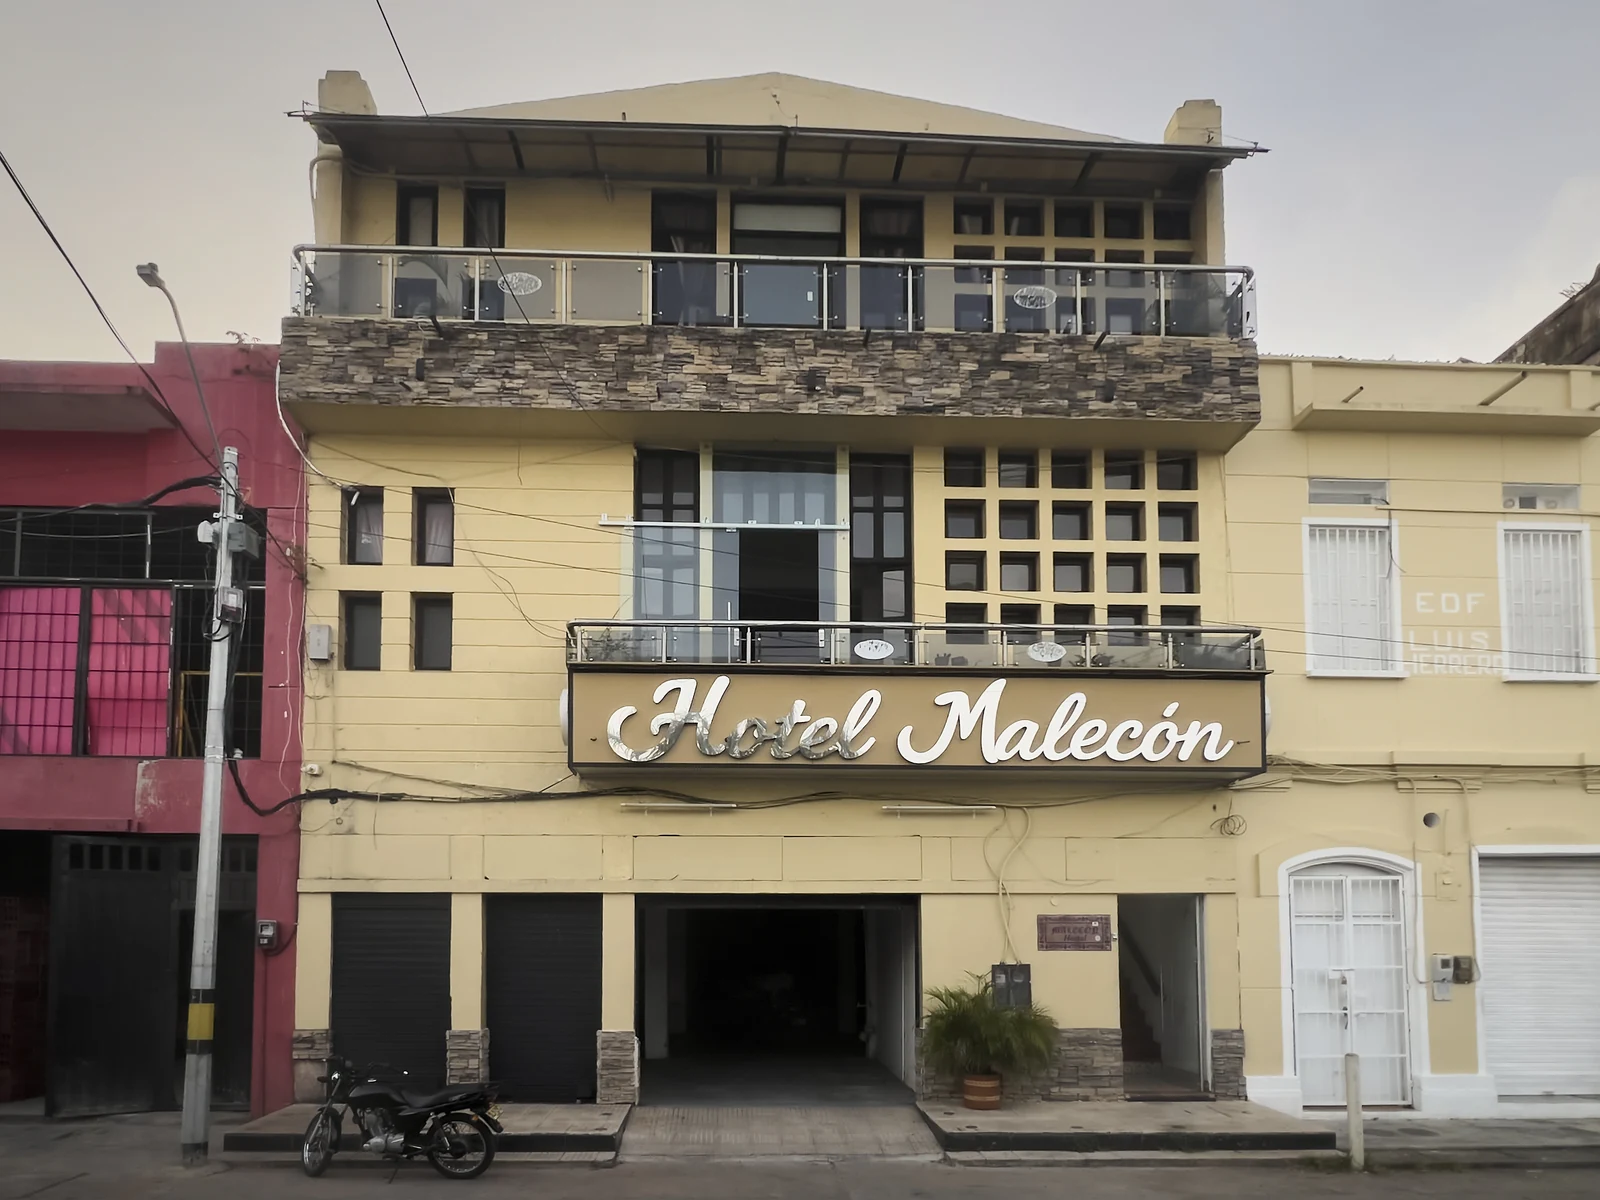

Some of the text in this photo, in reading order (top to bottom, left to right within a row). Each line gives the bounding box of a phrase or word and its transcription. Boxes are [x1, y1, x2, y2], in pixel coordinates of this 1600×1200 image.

[1415, 592, 1485, 614] EDF
[1408, 629, 1490, 652] LUIS
[606, 675, 1235, 764] Hotel Malecón
